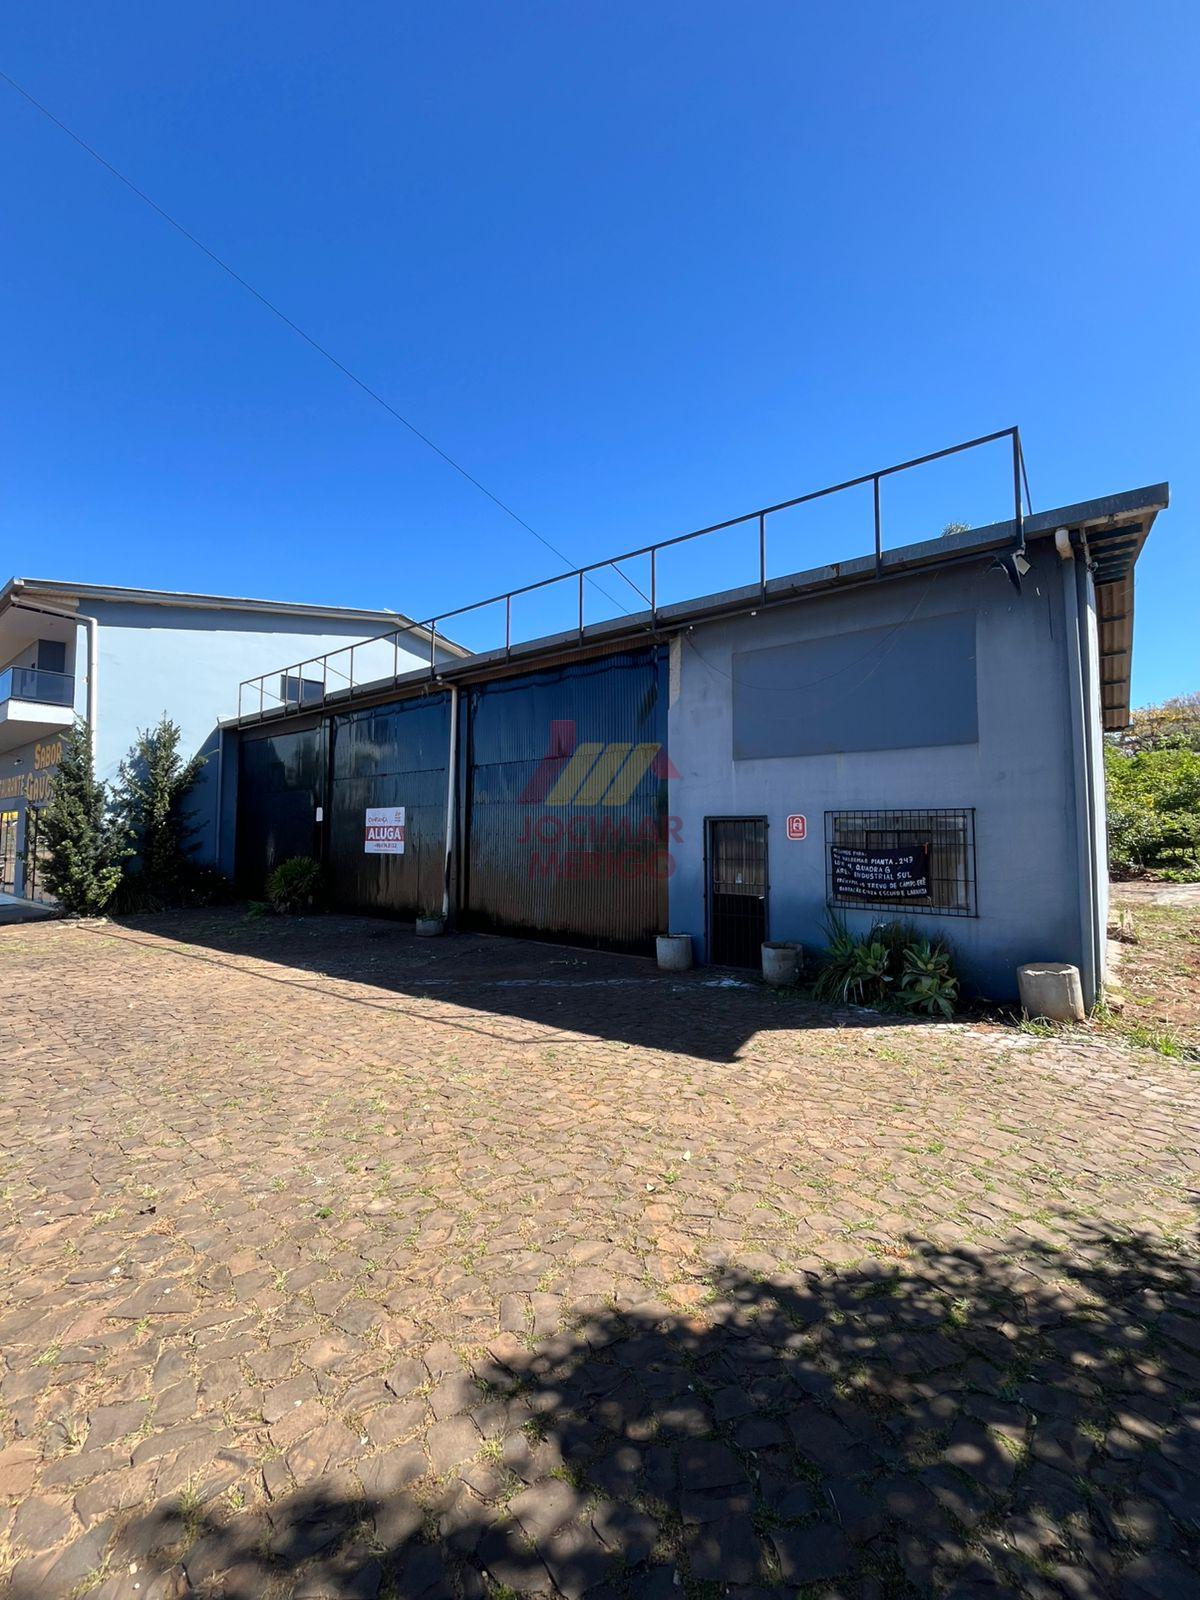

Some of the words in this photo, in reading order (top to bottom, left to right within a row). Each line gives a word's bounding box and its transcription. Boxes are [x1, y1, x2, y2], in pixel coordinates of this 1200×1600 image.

[34, 742, 62, 770] SABOR
[368, 827, 401, 840] ALUGA
[871, 857, 893, 865] PIANTA
[855, 864, 883, 873] QUADRA
[854, 871, 894, 880] INDUSTRIAL
[897, 871, 912, 880] SUL
